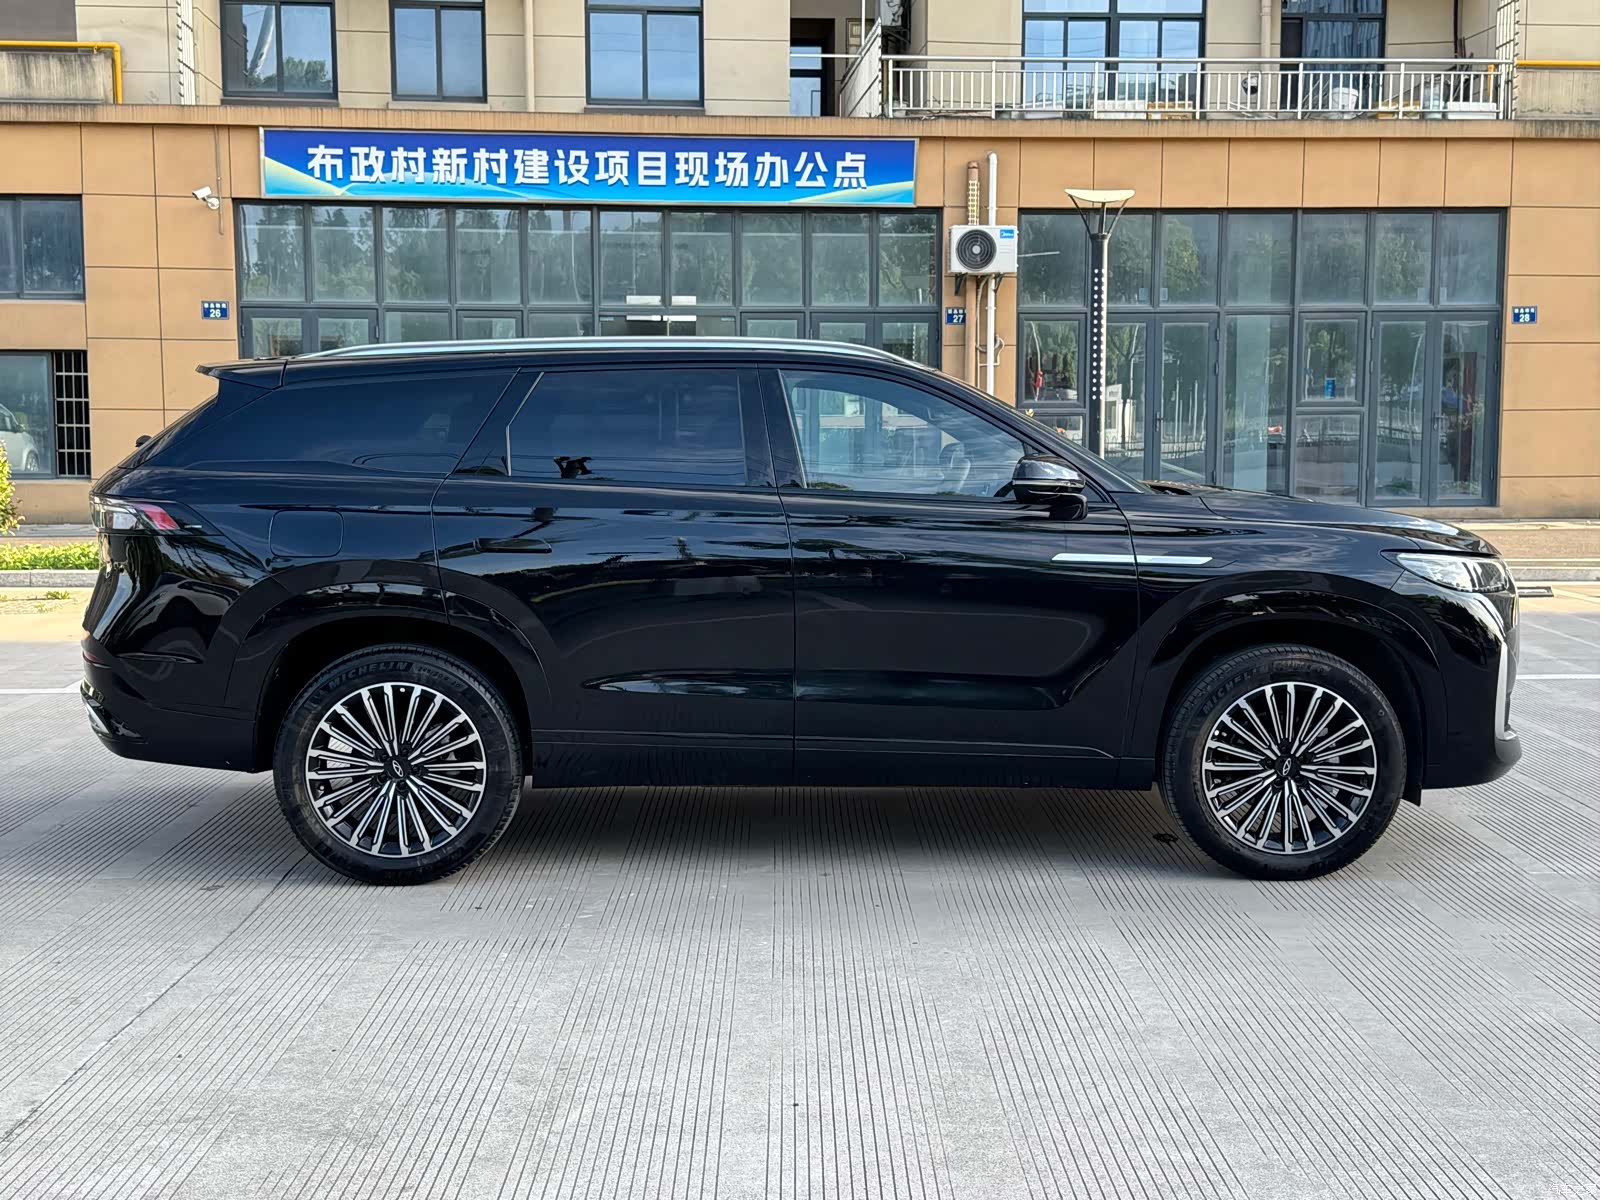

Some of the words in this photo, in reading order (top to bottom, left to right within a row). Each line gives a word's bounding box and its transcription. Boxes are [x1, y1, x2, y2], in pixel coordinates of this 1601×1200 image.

[306, 144, 868, 191] 布政村新村建设项目现场办公点
[210, 308, 221, 318] 26
[1519, 314, 1530, 322] 28
[952, 314, 964, 323] 27
[328, 661, 408, 690] MICHELIN
